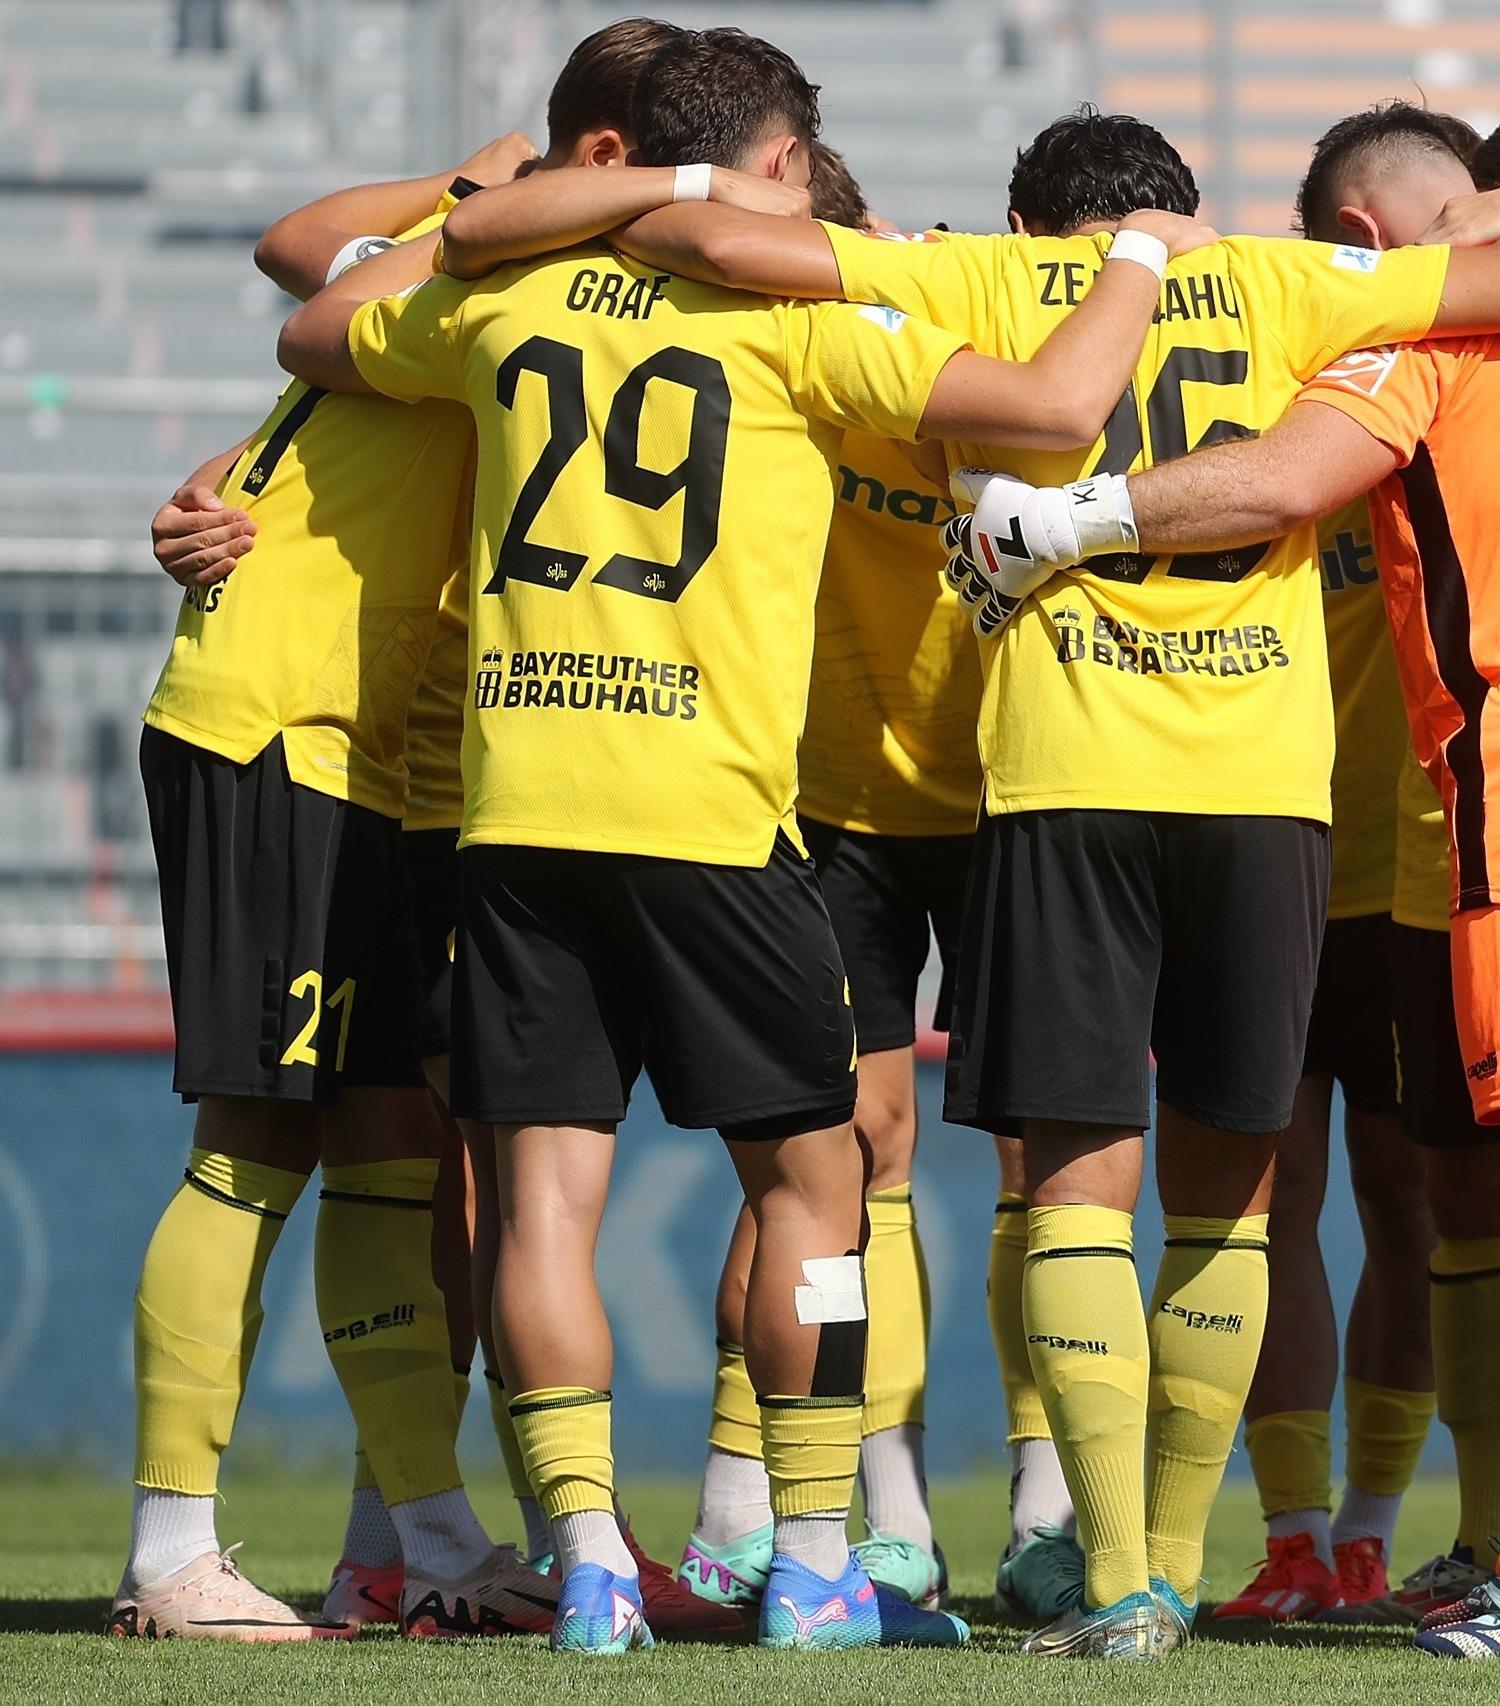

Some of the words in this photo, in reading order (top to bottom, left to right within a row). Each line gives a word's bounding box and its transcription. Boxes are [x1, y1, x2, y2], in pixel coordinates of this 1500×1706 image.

[566, 269, 671, 320] GRAF
[481, 335, 732, 603] 29
[1093, 615, 1281, 656] BAYREUTHER
[510, 651, 699, 691] BAYREUTHER
[1093, 641, 1289, 677] BRAUHAUS
[503, 680, 697, 720] BRAUHAUS
[279, 969, 357, 1072] 21
[323, 1304, 416, 1344] capelli
[1161, 1301, 1243, 1327] capelli
[1028, 1335, 1107, 1353] capelli
